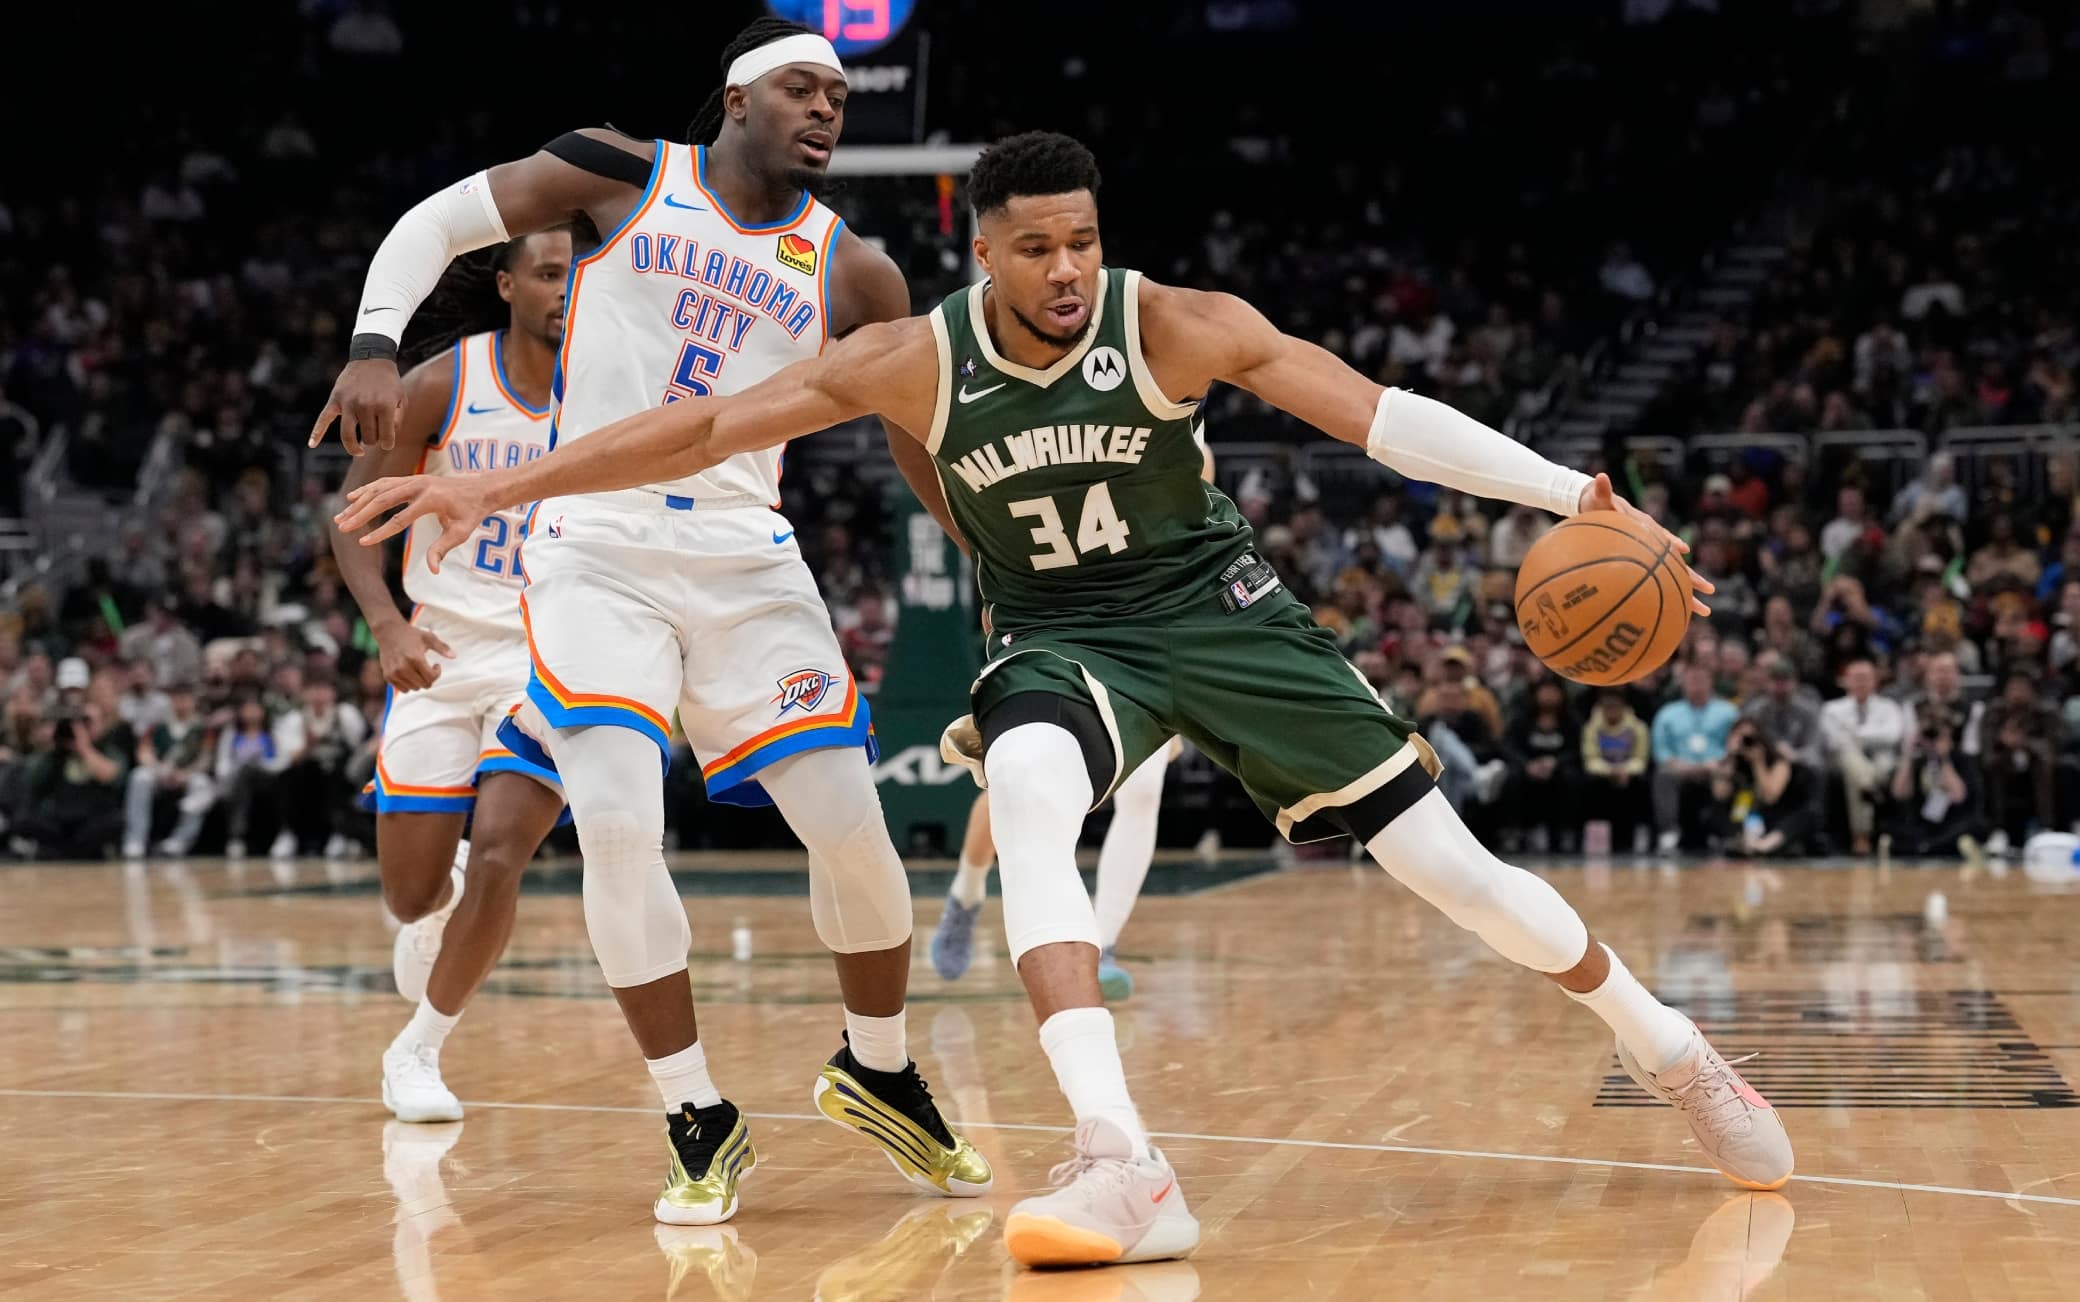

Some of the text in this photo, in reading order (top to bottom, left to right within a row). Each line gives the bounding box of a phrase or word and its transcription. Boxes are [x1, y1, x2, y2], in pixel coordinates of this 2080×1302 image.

[631, 232, 816, 341] OKLAHOMA
[671, 288, 757, 352] CITY
[662, 339, 727, 406] 5
[950, 424, 1153, 494] MILWAUKEE
[1007, 480, 1131, 572] 34
[780, 674, 820, 709] OKC
